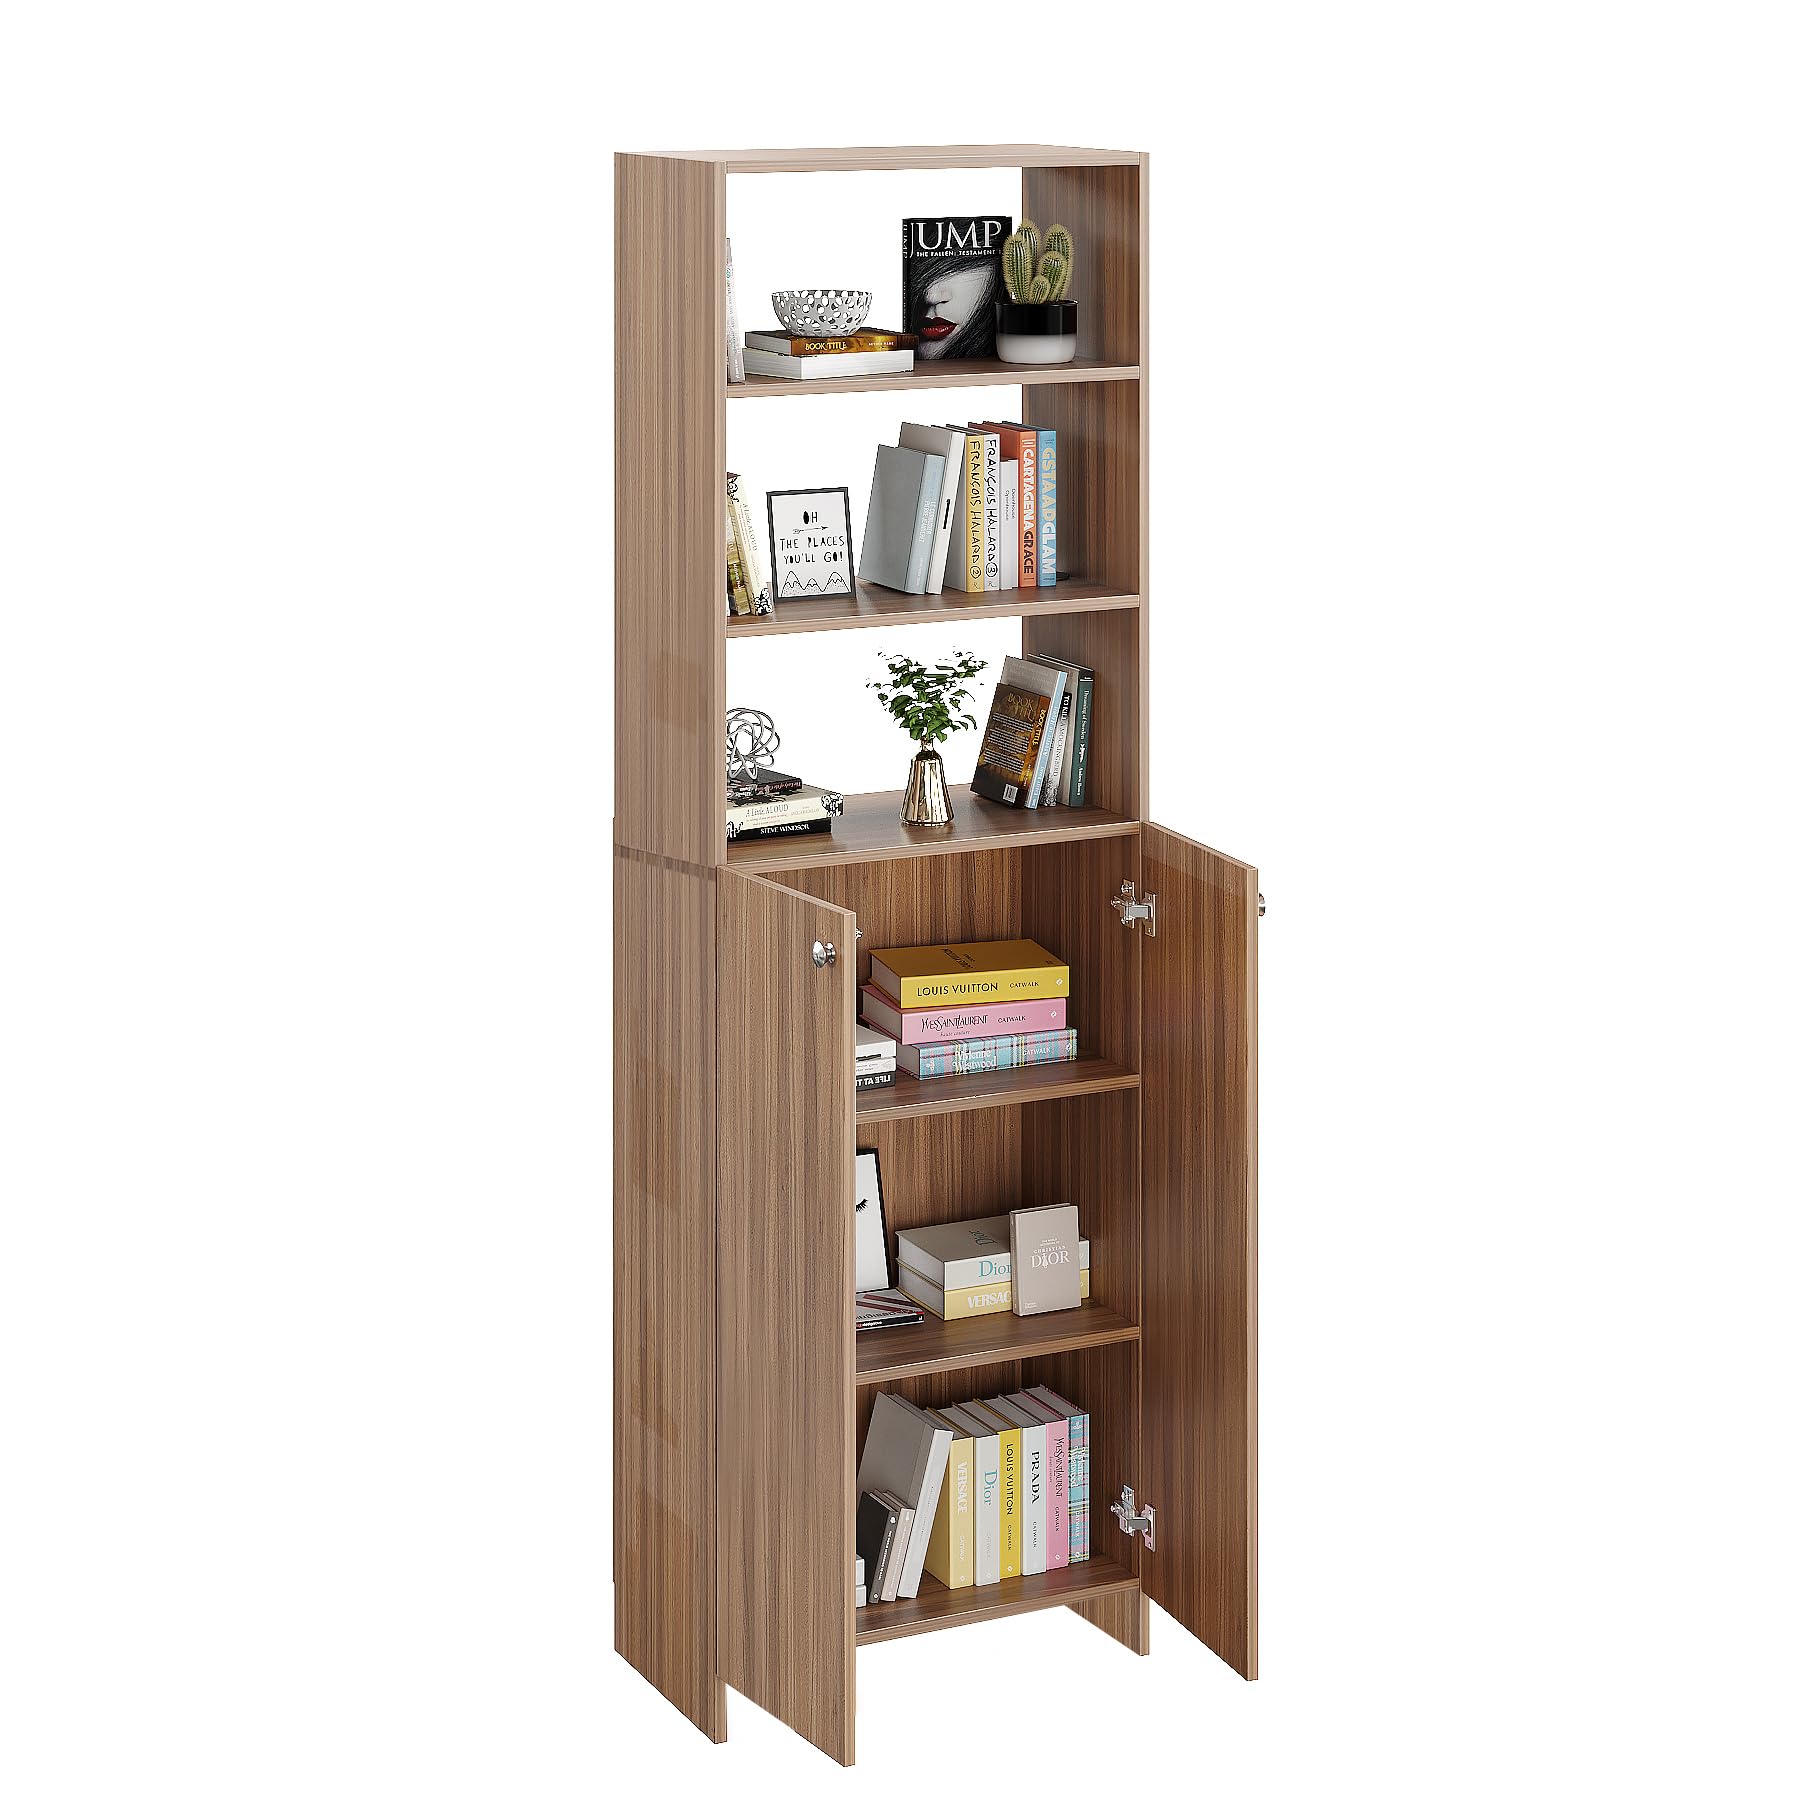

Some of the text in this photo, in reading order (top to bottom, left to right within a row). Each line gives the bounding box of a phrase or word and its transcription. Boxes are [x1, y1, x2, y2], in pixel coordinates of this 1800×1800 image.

[910, 220, 1002, 258] JUMP
[805, 343, 826, 351] BOOK
[827, 342, 848, 350] TITLE
[803, 510, 818, 524] OH
[780, 536, 845, 551] THE PLACES
[970, 510, 981, 564] HALARD
[986, 508, 998, 562] HALARD
[784, 552, 843, 564] YOU'LL GO!
[1064, 696, 1070, 705] TO
[1037, 709, 1046, 728] BOOK
[1033, 728, 1042, 745] TITLE
[766, 804, 788, 814] ALOUD
[917, 986, 948, 996] LOUIS
[952, 983, 998, 994] VUITTON
[1023, 1047, 1051, 1055] CATWALK
[978, 1260, 1012, 1277] Dior
[968, 1290, 1011, 1308] VERSAC
[1032, 1452, 1040, 1504] PRADA
[958, 1461, 968, 1513] VERSACE
[984, 1469, 997, 1506] Dior
